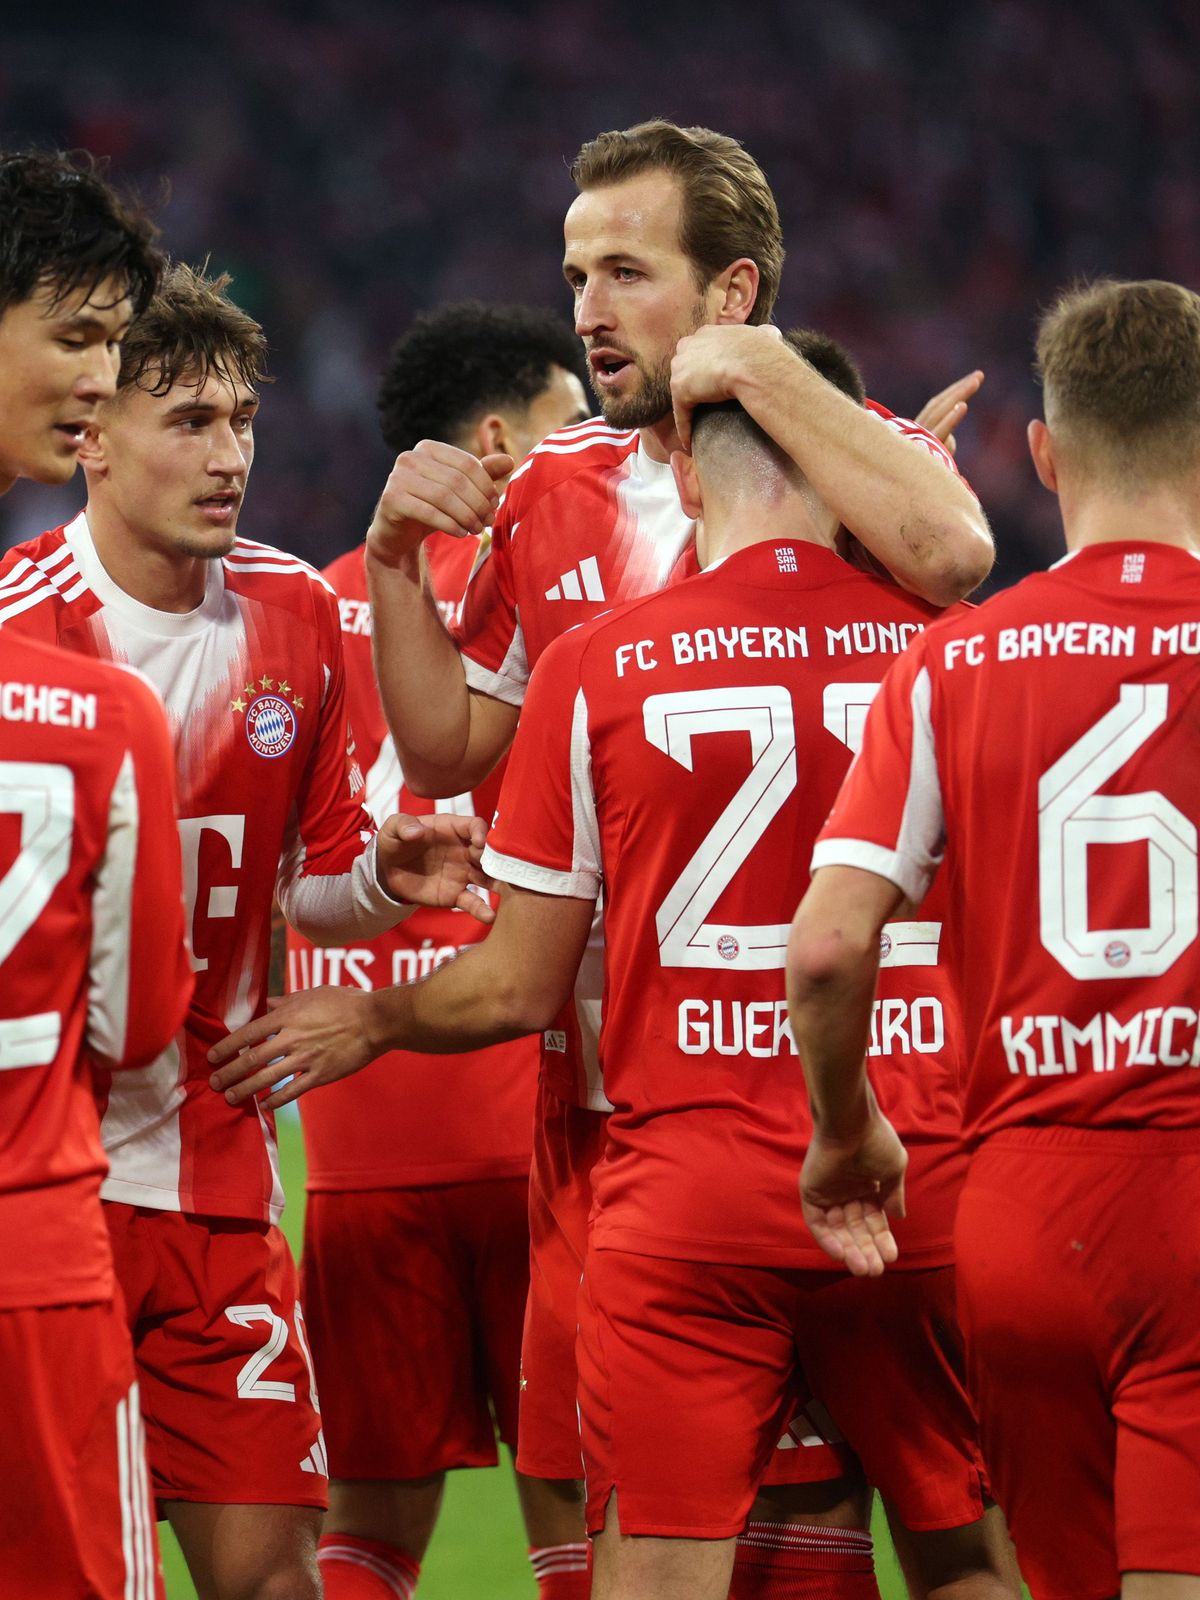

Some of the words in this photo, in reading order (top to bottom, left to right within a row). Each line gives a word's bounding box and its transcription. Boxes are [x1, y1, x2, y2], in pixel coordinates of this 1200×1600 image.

[774, 547, 794, 556] MIA
[776, 556, 796, 564] SAN
[778, 563, 798, 573] MIA
[615, 640, 658, 677] FC
[671, 627, 808, 665] BAYERN
[824, 622, 924, 656] MÜNC
[944, 634, 985, 671] FC
[997, 621, 1136, 662] BAYERN
[0, 681, 97, 731] CHEN
[248, 708, 258, 723] FC
[257, 699, 292, 723] BAYERN
[249, 731, 292, 754] MÜNCHEN
[1038, 684, 1200, 980] 6
[677, 997, 944, 1058] GUERIRO
[1000, 1006, 1200, 1077] KIMMIC
